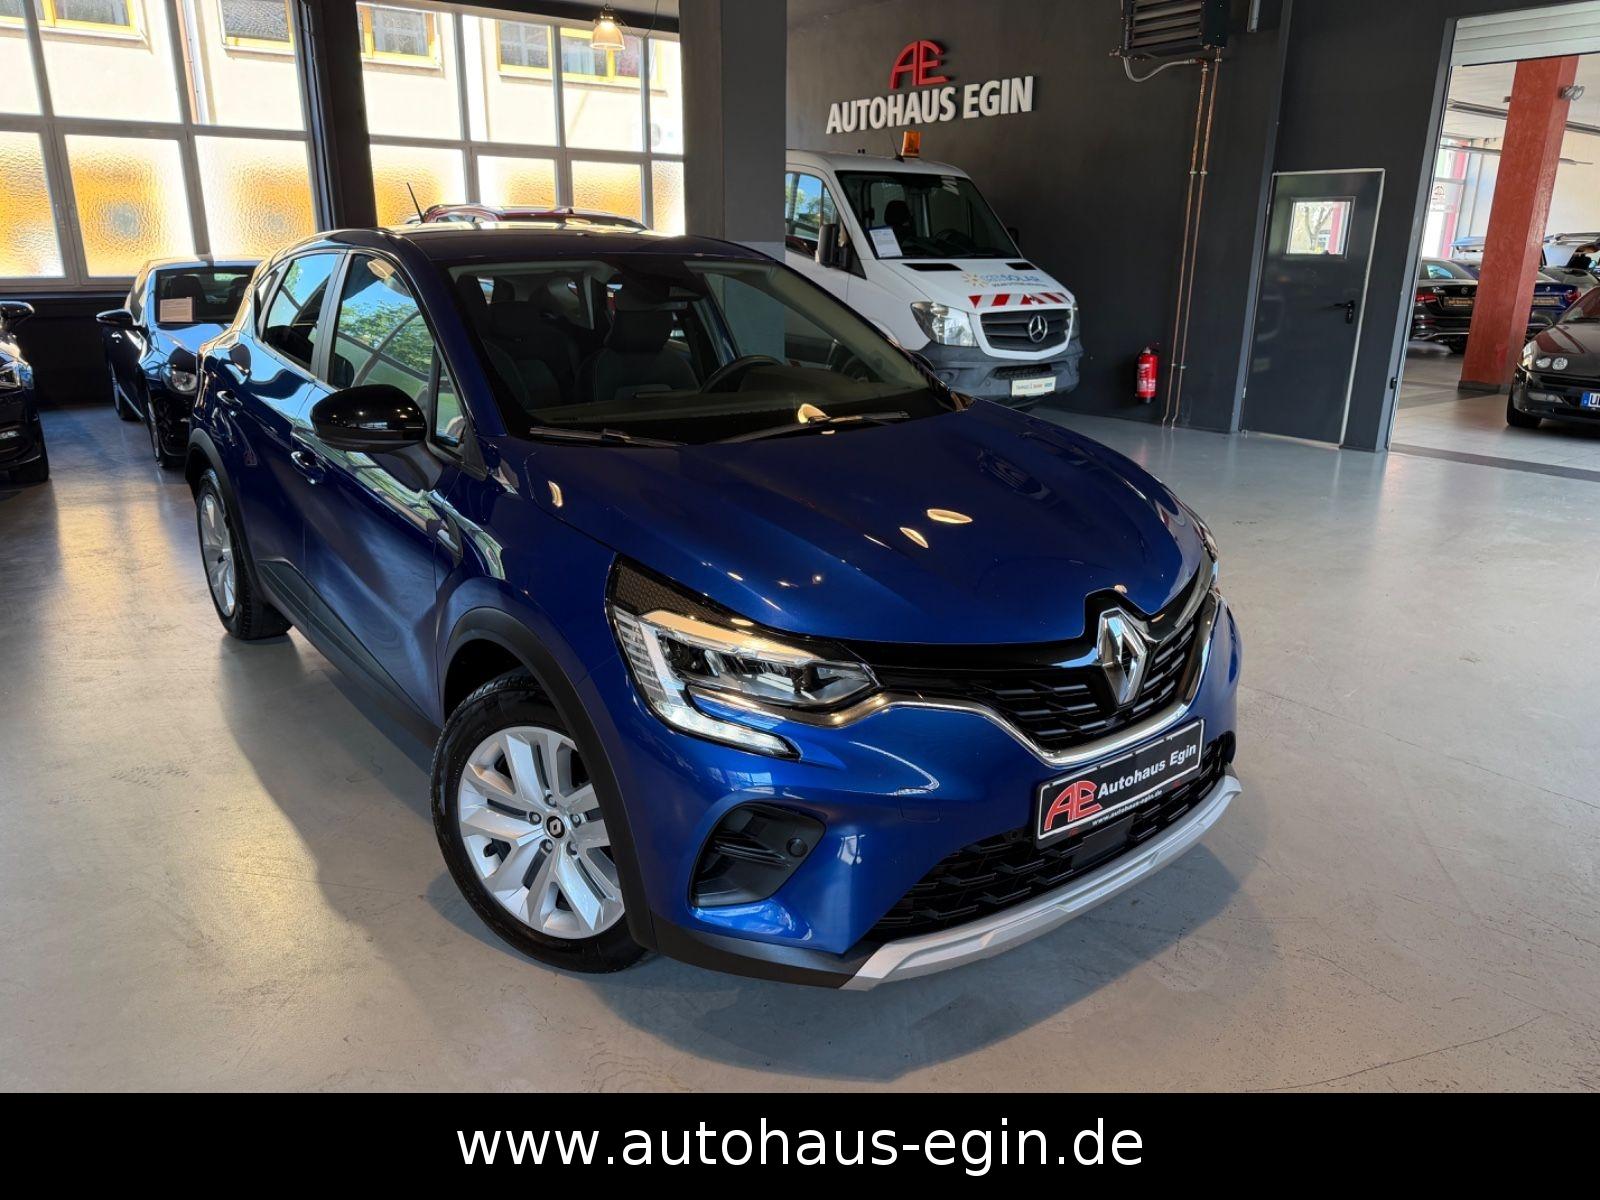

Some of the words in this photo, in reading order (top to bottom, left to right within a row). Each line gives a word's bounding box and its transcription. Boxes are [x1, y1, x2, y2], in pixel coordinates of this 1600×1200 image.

[889, 40, 950, 89] AE
[826, 86, 957, 135] AUTOHAUS
[963, 76, 1034, 120] EGIN
[1097, 760, 1166, 799] Autohaus
[1169, 744, 1197, 767] Egin
[1044, 780, 1103, 832] AE
